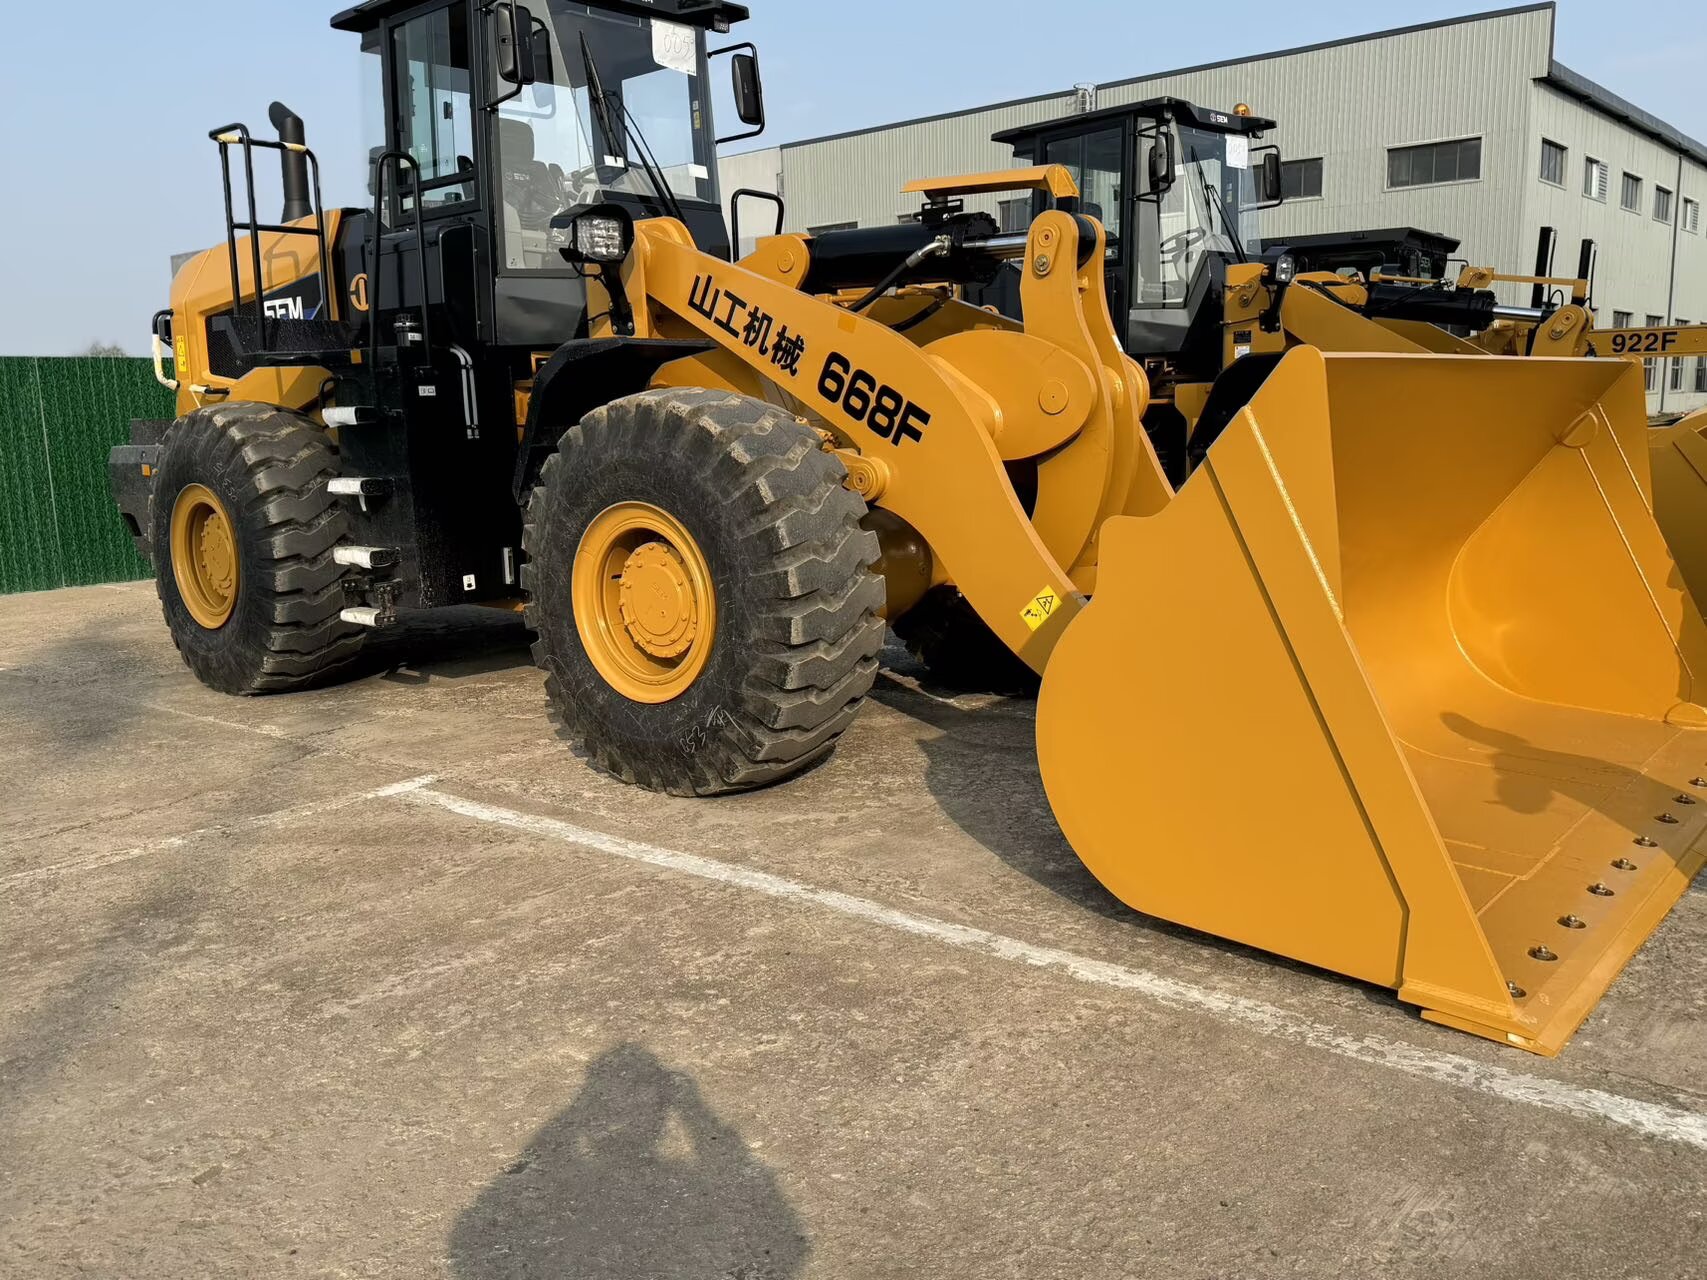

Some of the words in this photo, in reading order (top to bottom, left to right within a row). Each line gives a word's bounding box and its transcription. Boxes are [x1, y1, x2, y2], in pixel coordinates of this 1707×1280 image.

[688, 274, 806, 377] 山工机械
[1611, 331, 1679, 354] 922F
[817, 351, 931, 447] 668F
